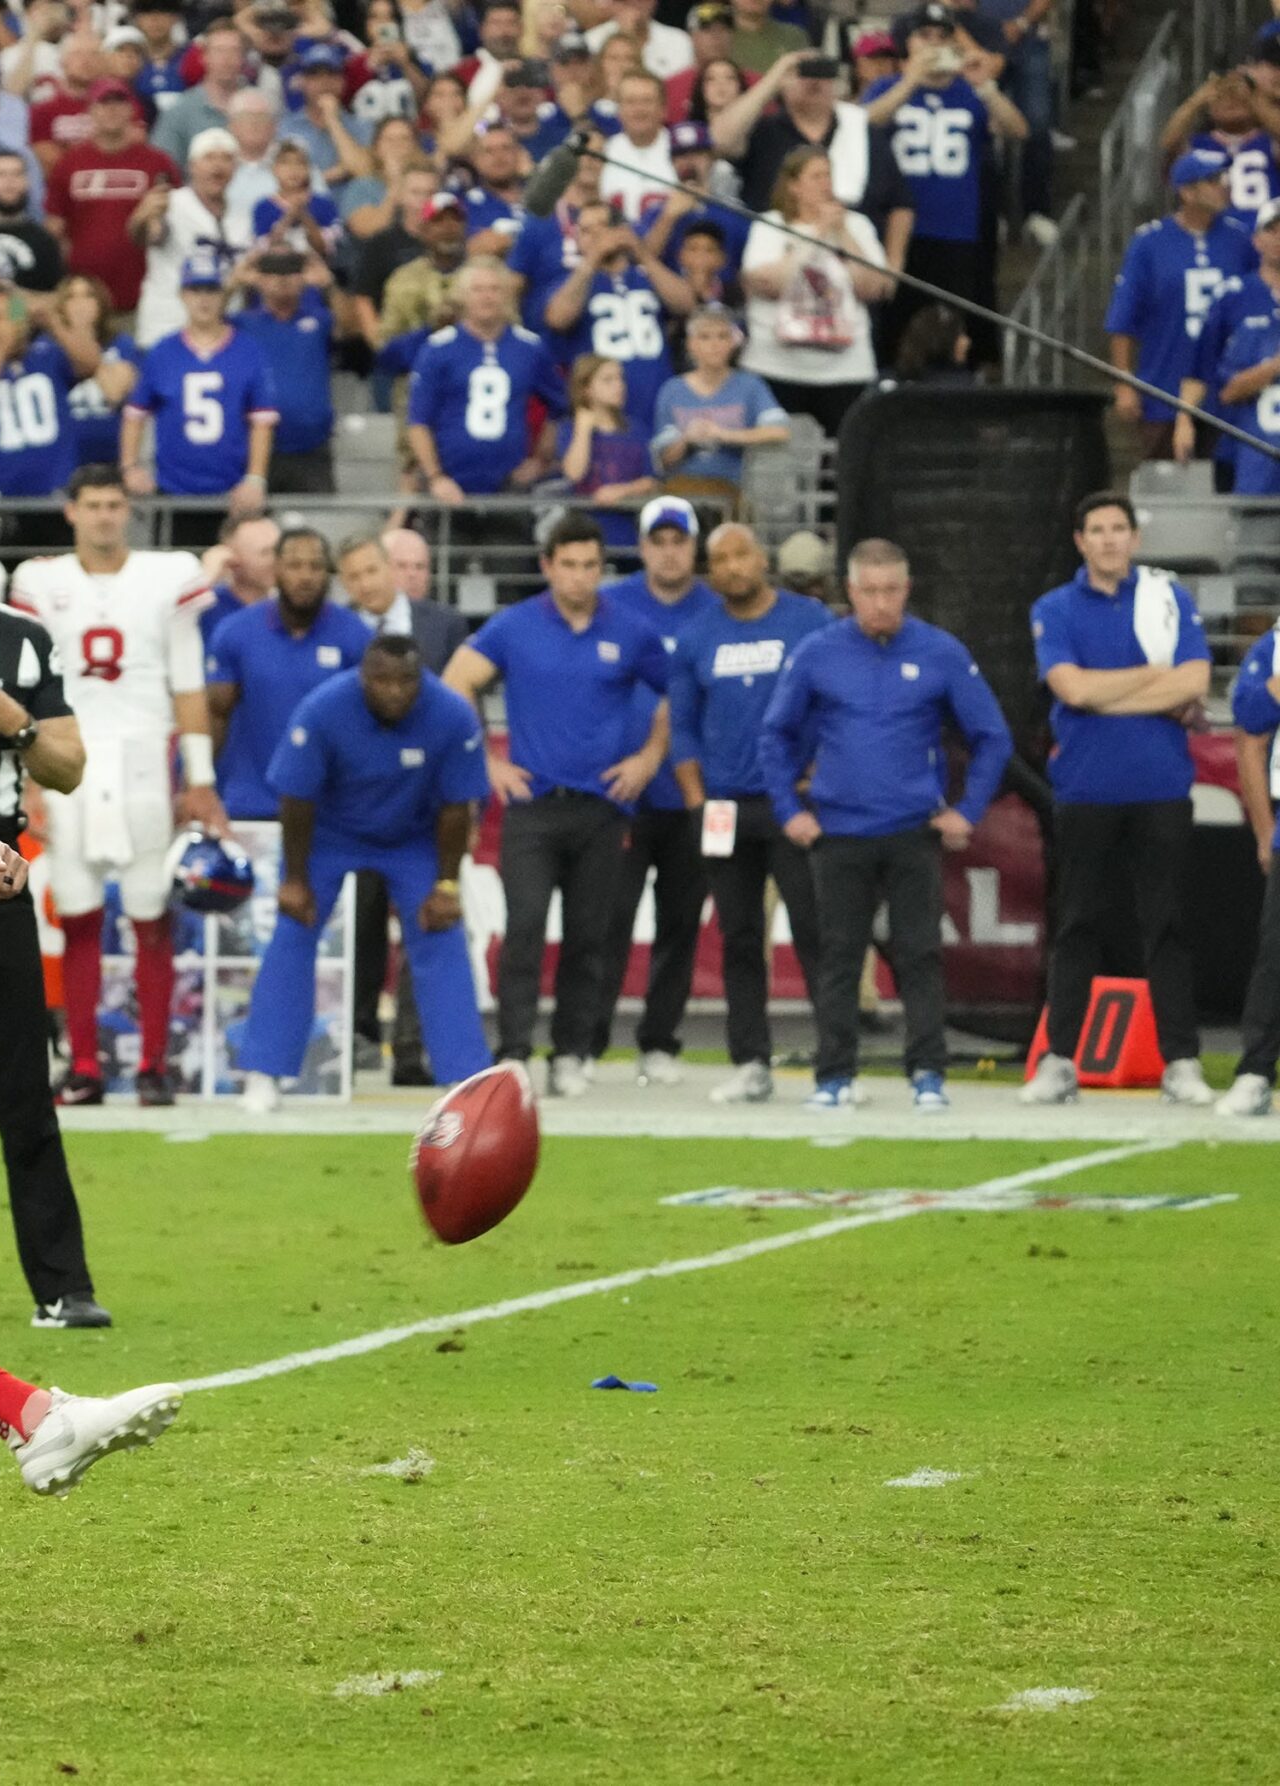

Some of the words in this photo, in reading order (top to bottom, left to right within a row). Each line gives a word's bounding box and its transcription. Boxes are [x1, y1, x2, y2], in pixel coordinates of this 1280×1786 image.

[891, 106, 969, 176] 26
[588, 290, 662, 361] 26
[183, 371, 222, 444] 5
[466, 365, 511, 440] 8
[80, 628, 122, 682] 8
[1076, 991, 1135, 1073] 0
